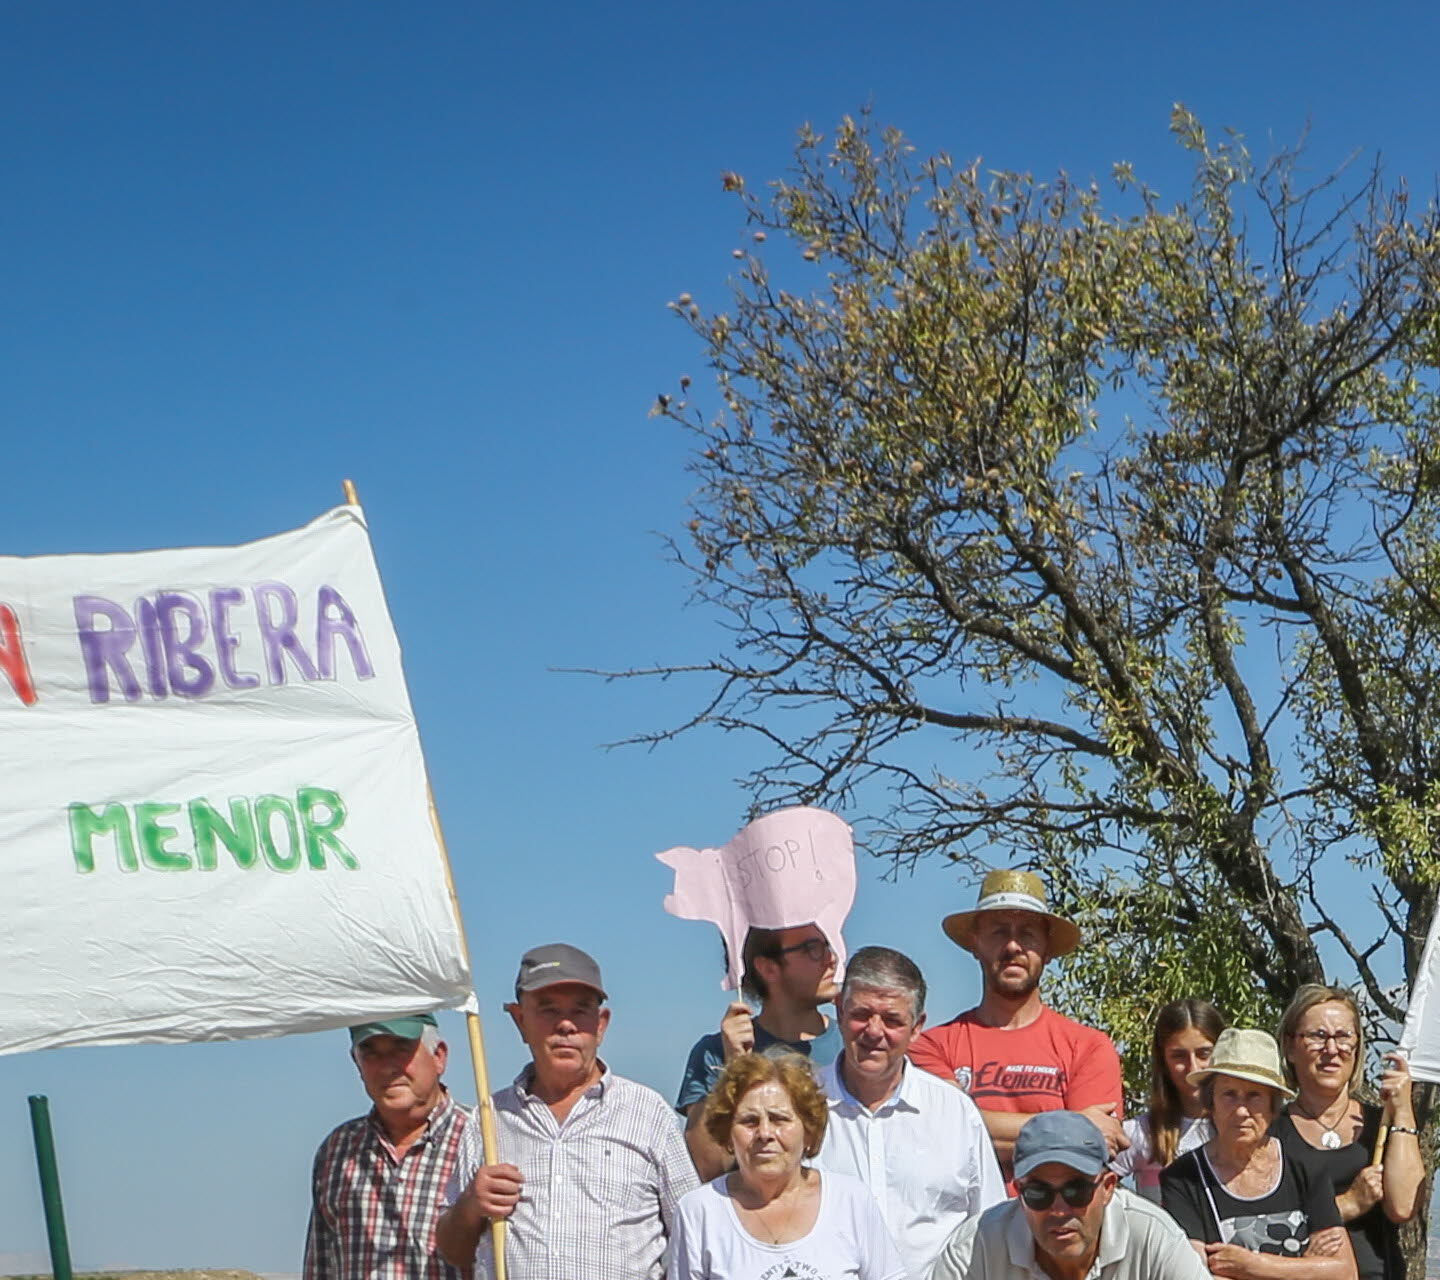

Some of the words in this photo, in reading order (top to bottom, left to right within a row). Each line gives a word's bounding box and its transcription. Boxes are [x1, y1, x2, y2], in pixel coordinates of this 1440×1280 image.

[73, 582, 376, 704] RIBERA
[68, 787, 359, 873] MENOR
[736, 829, 824, 890] STOP!
[975, 1061, 1068, 1091] Element
[795, 1261, 819, 1276] TWO
